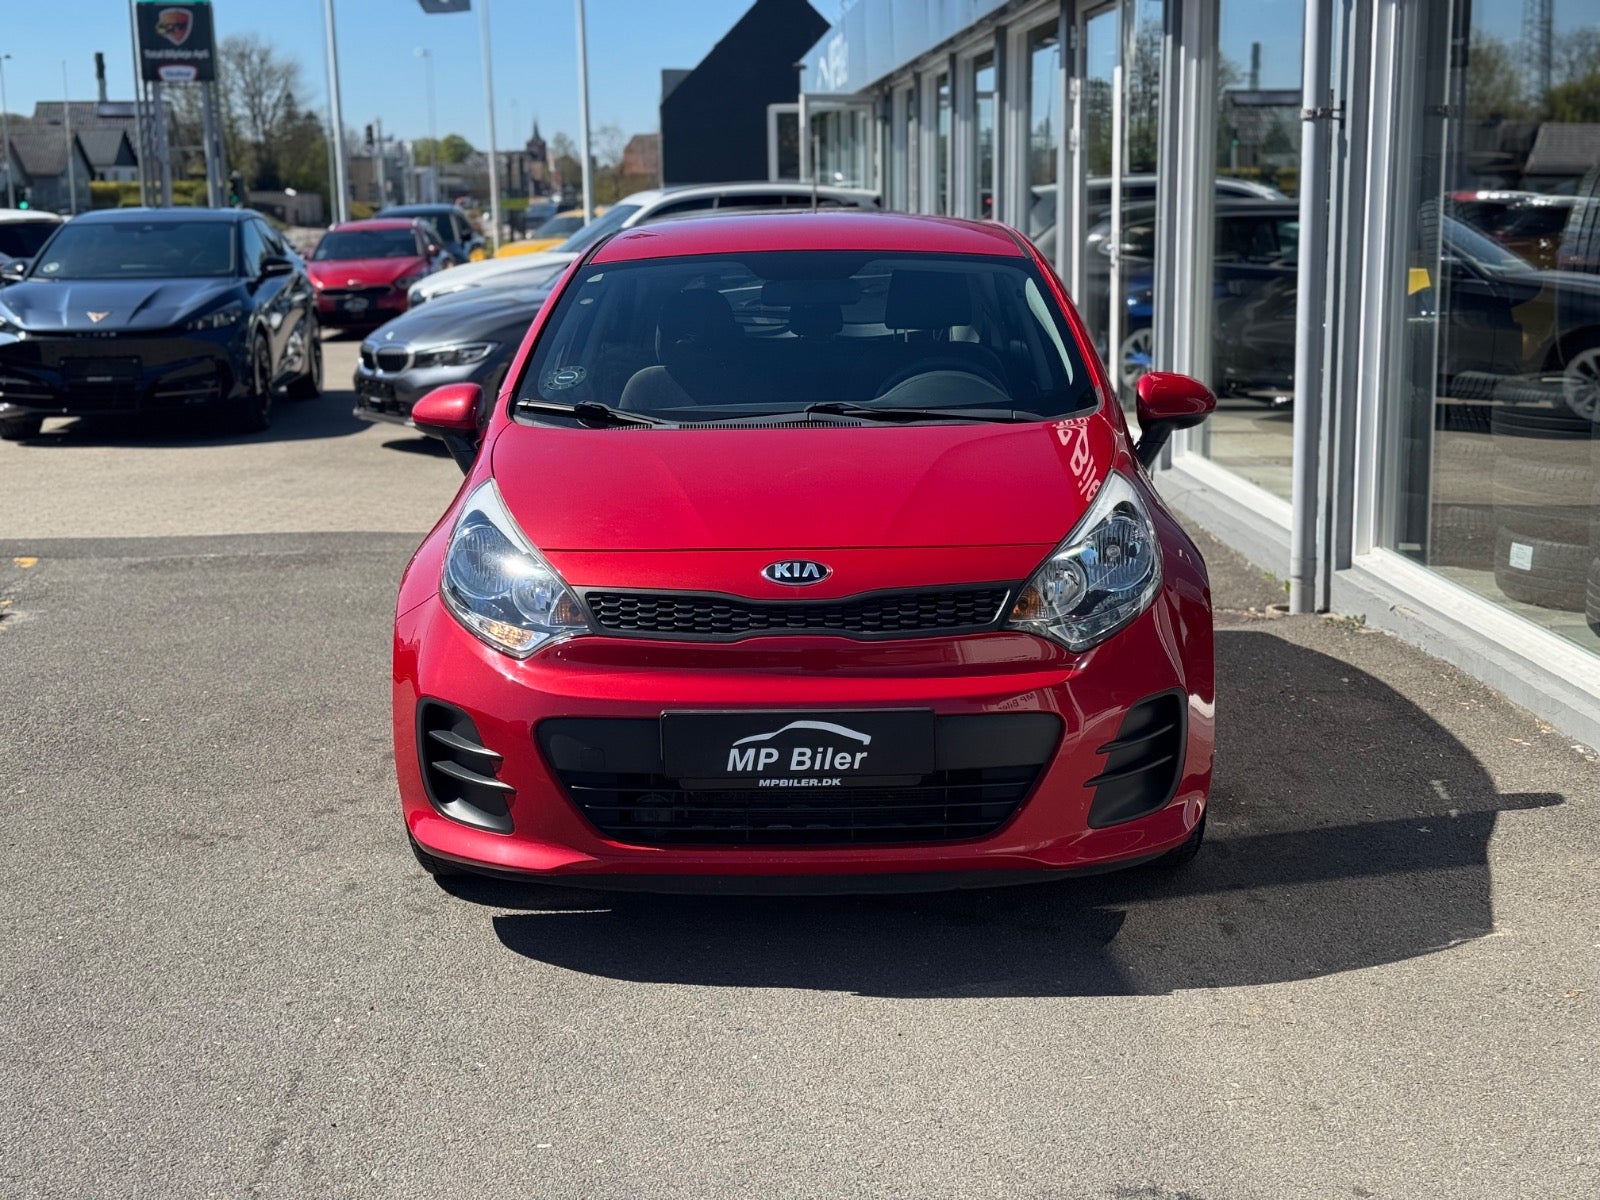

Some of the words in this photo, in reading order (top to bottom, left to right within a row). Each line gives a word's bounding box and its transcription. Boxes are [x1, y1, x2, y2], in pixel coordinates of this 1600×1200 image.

[774, 562, 820, 579] KIA
[726, 748, 779, 772] MP
[789, 747, 869, 771] Biler
[758, 778, 842, 787] MPBILER.DK
